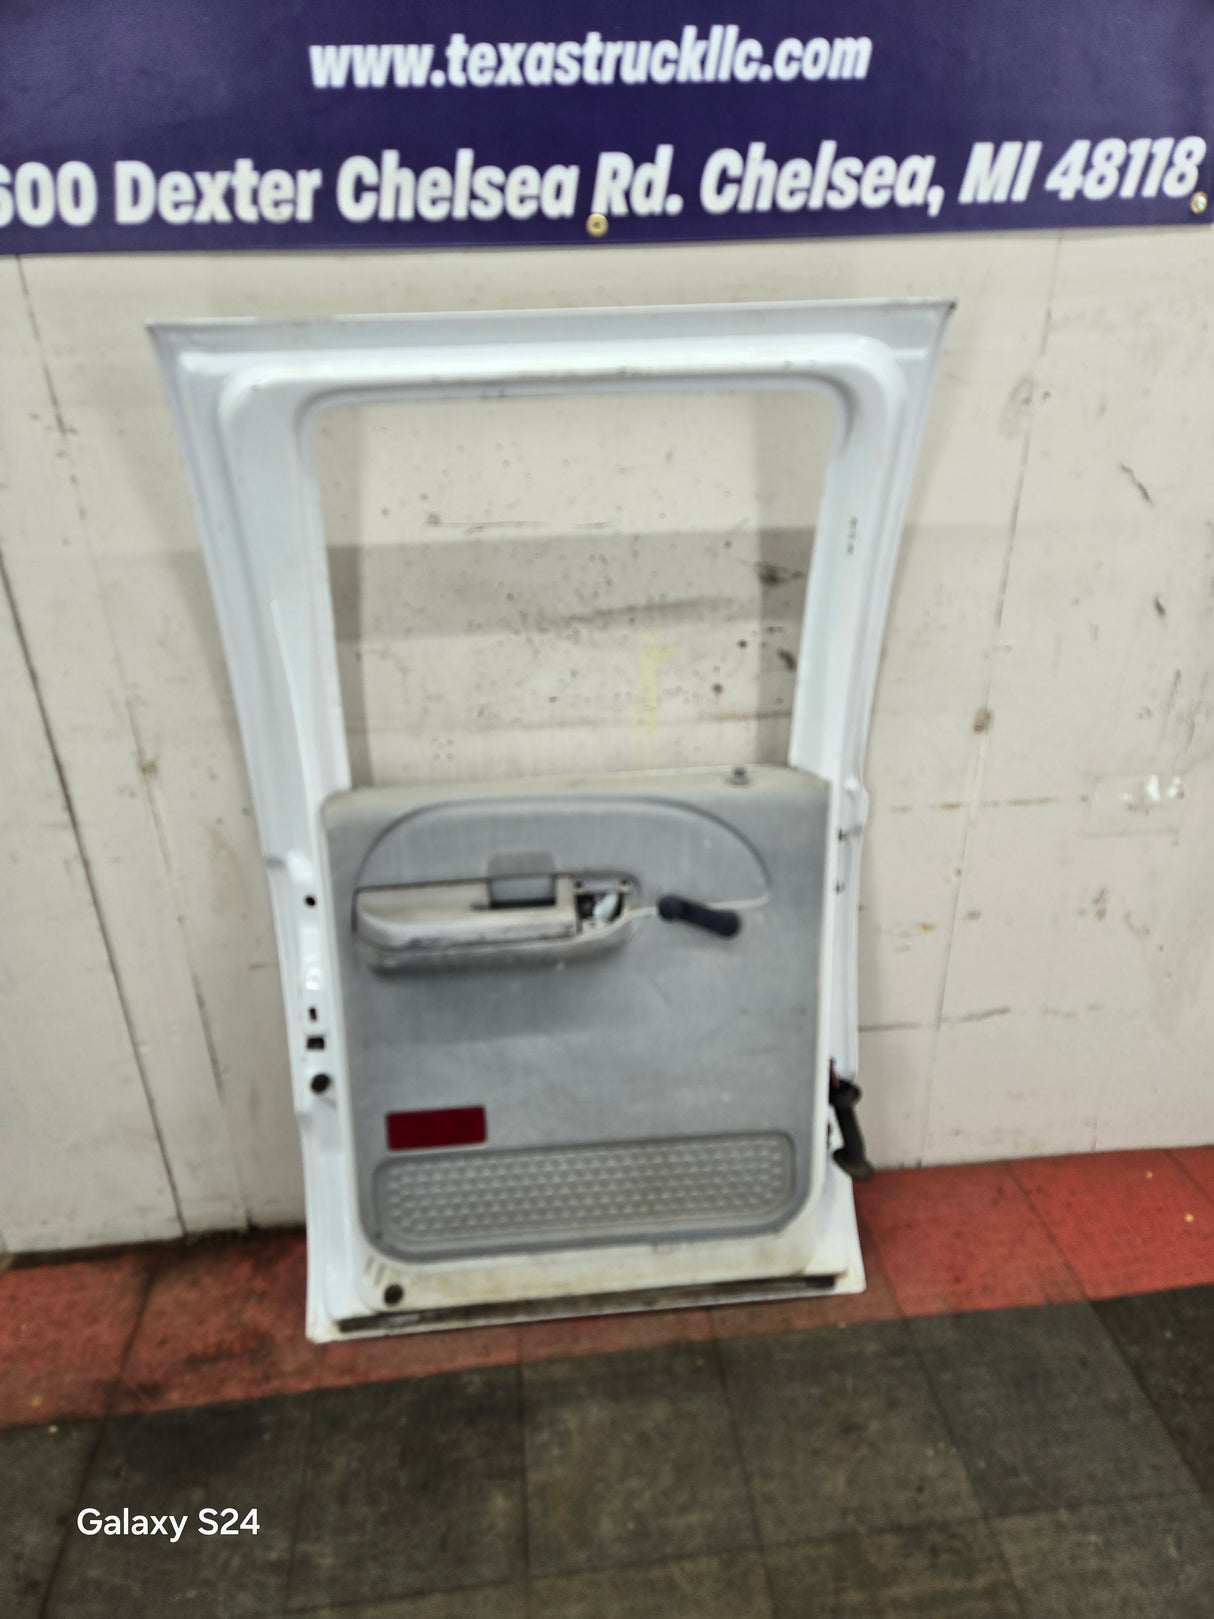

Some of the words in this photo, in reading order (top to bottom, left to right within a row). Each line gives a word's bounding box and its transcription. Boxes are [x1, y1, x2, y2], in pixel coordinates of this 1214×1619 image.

[309, 25, 872, 88] www.texastruckllc.com
[115, 158, 322, 224] Dexter
[337, 148, 580, 222] Chelsea
[591, 144, 684, 216] Rd.
[701, 140, 945, 217] Chelsea,
[958, 141, 1042, 204] MI
[1044, 136, 1207, 201] 48118
